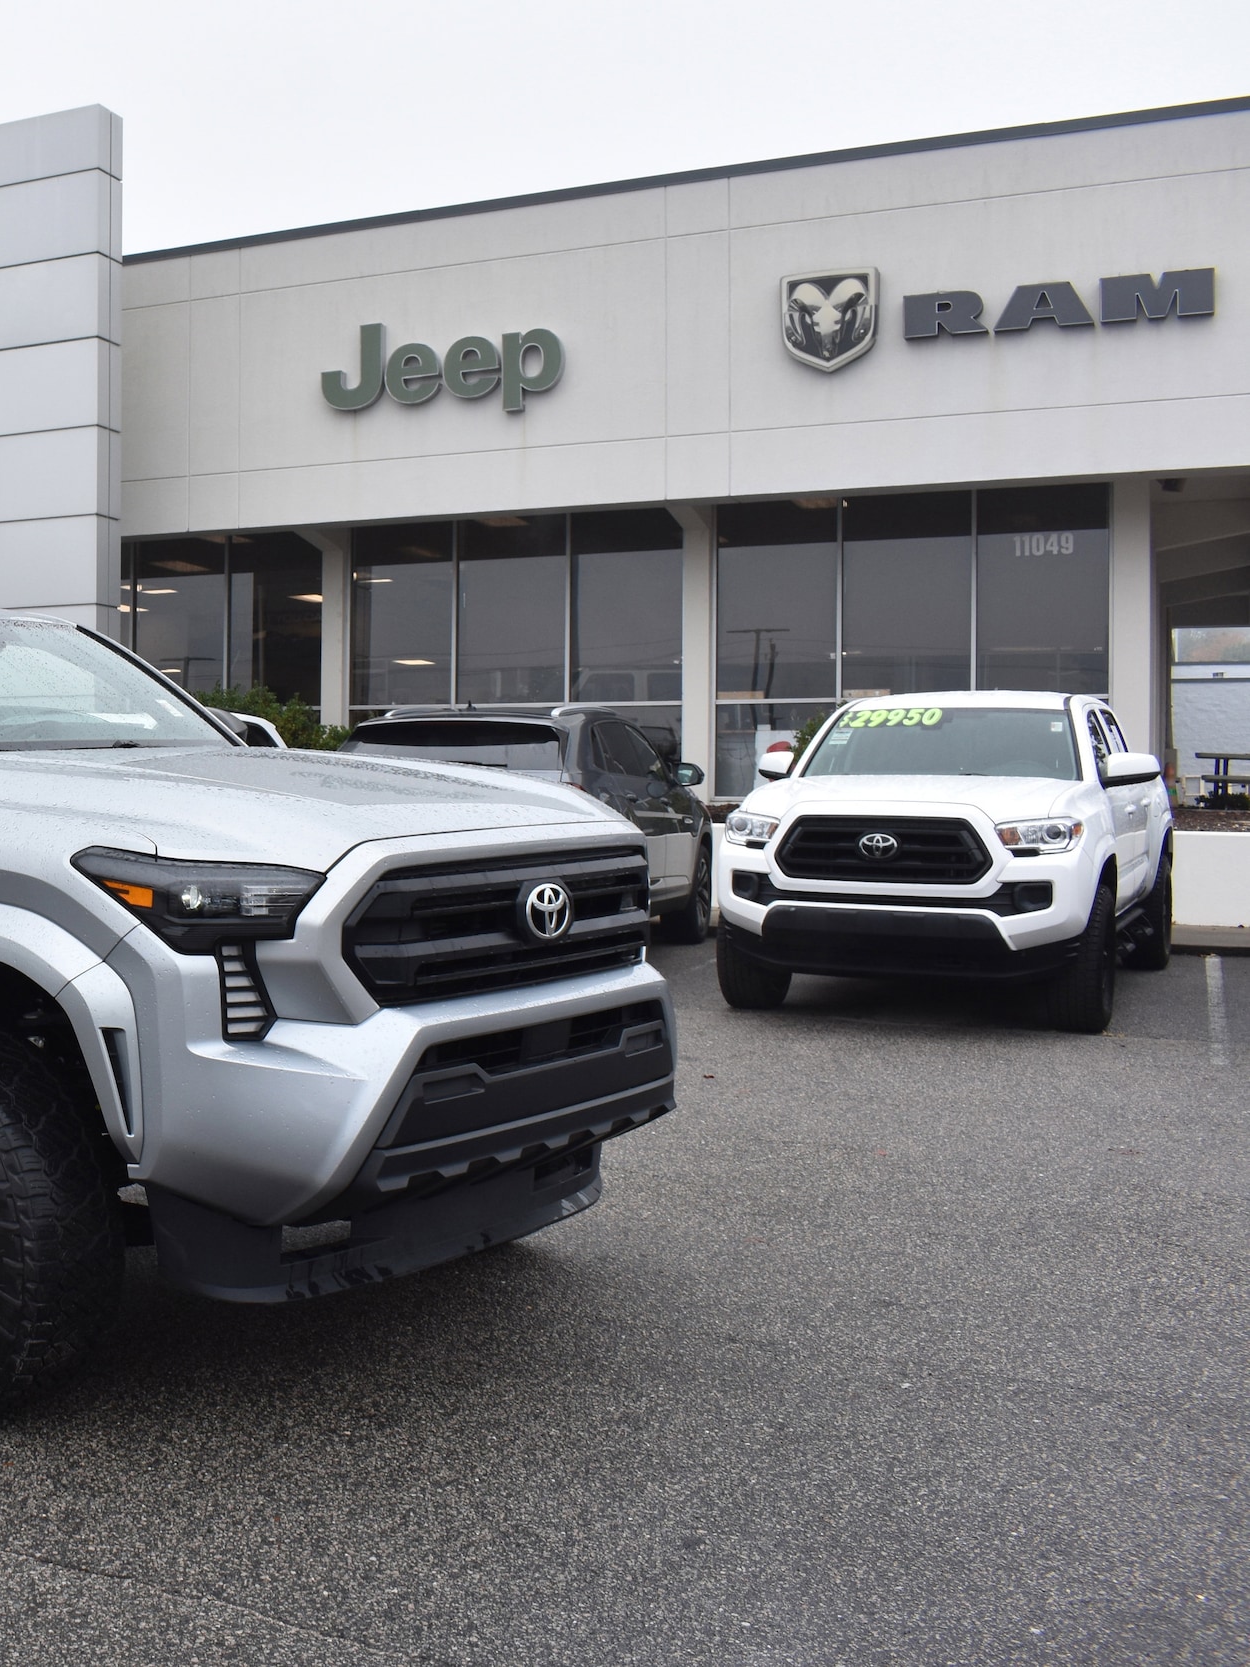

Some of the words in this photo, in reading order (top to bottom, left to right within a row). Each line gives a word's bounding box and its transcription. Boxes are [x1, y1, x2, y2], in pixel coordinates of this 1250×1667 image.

[902, 266, 1217, 341] RAM
[320, 322, 567, 413] Jeep
[1013, 532, 1074, 557] 11049
[839, 707, 943, 728] $29950
